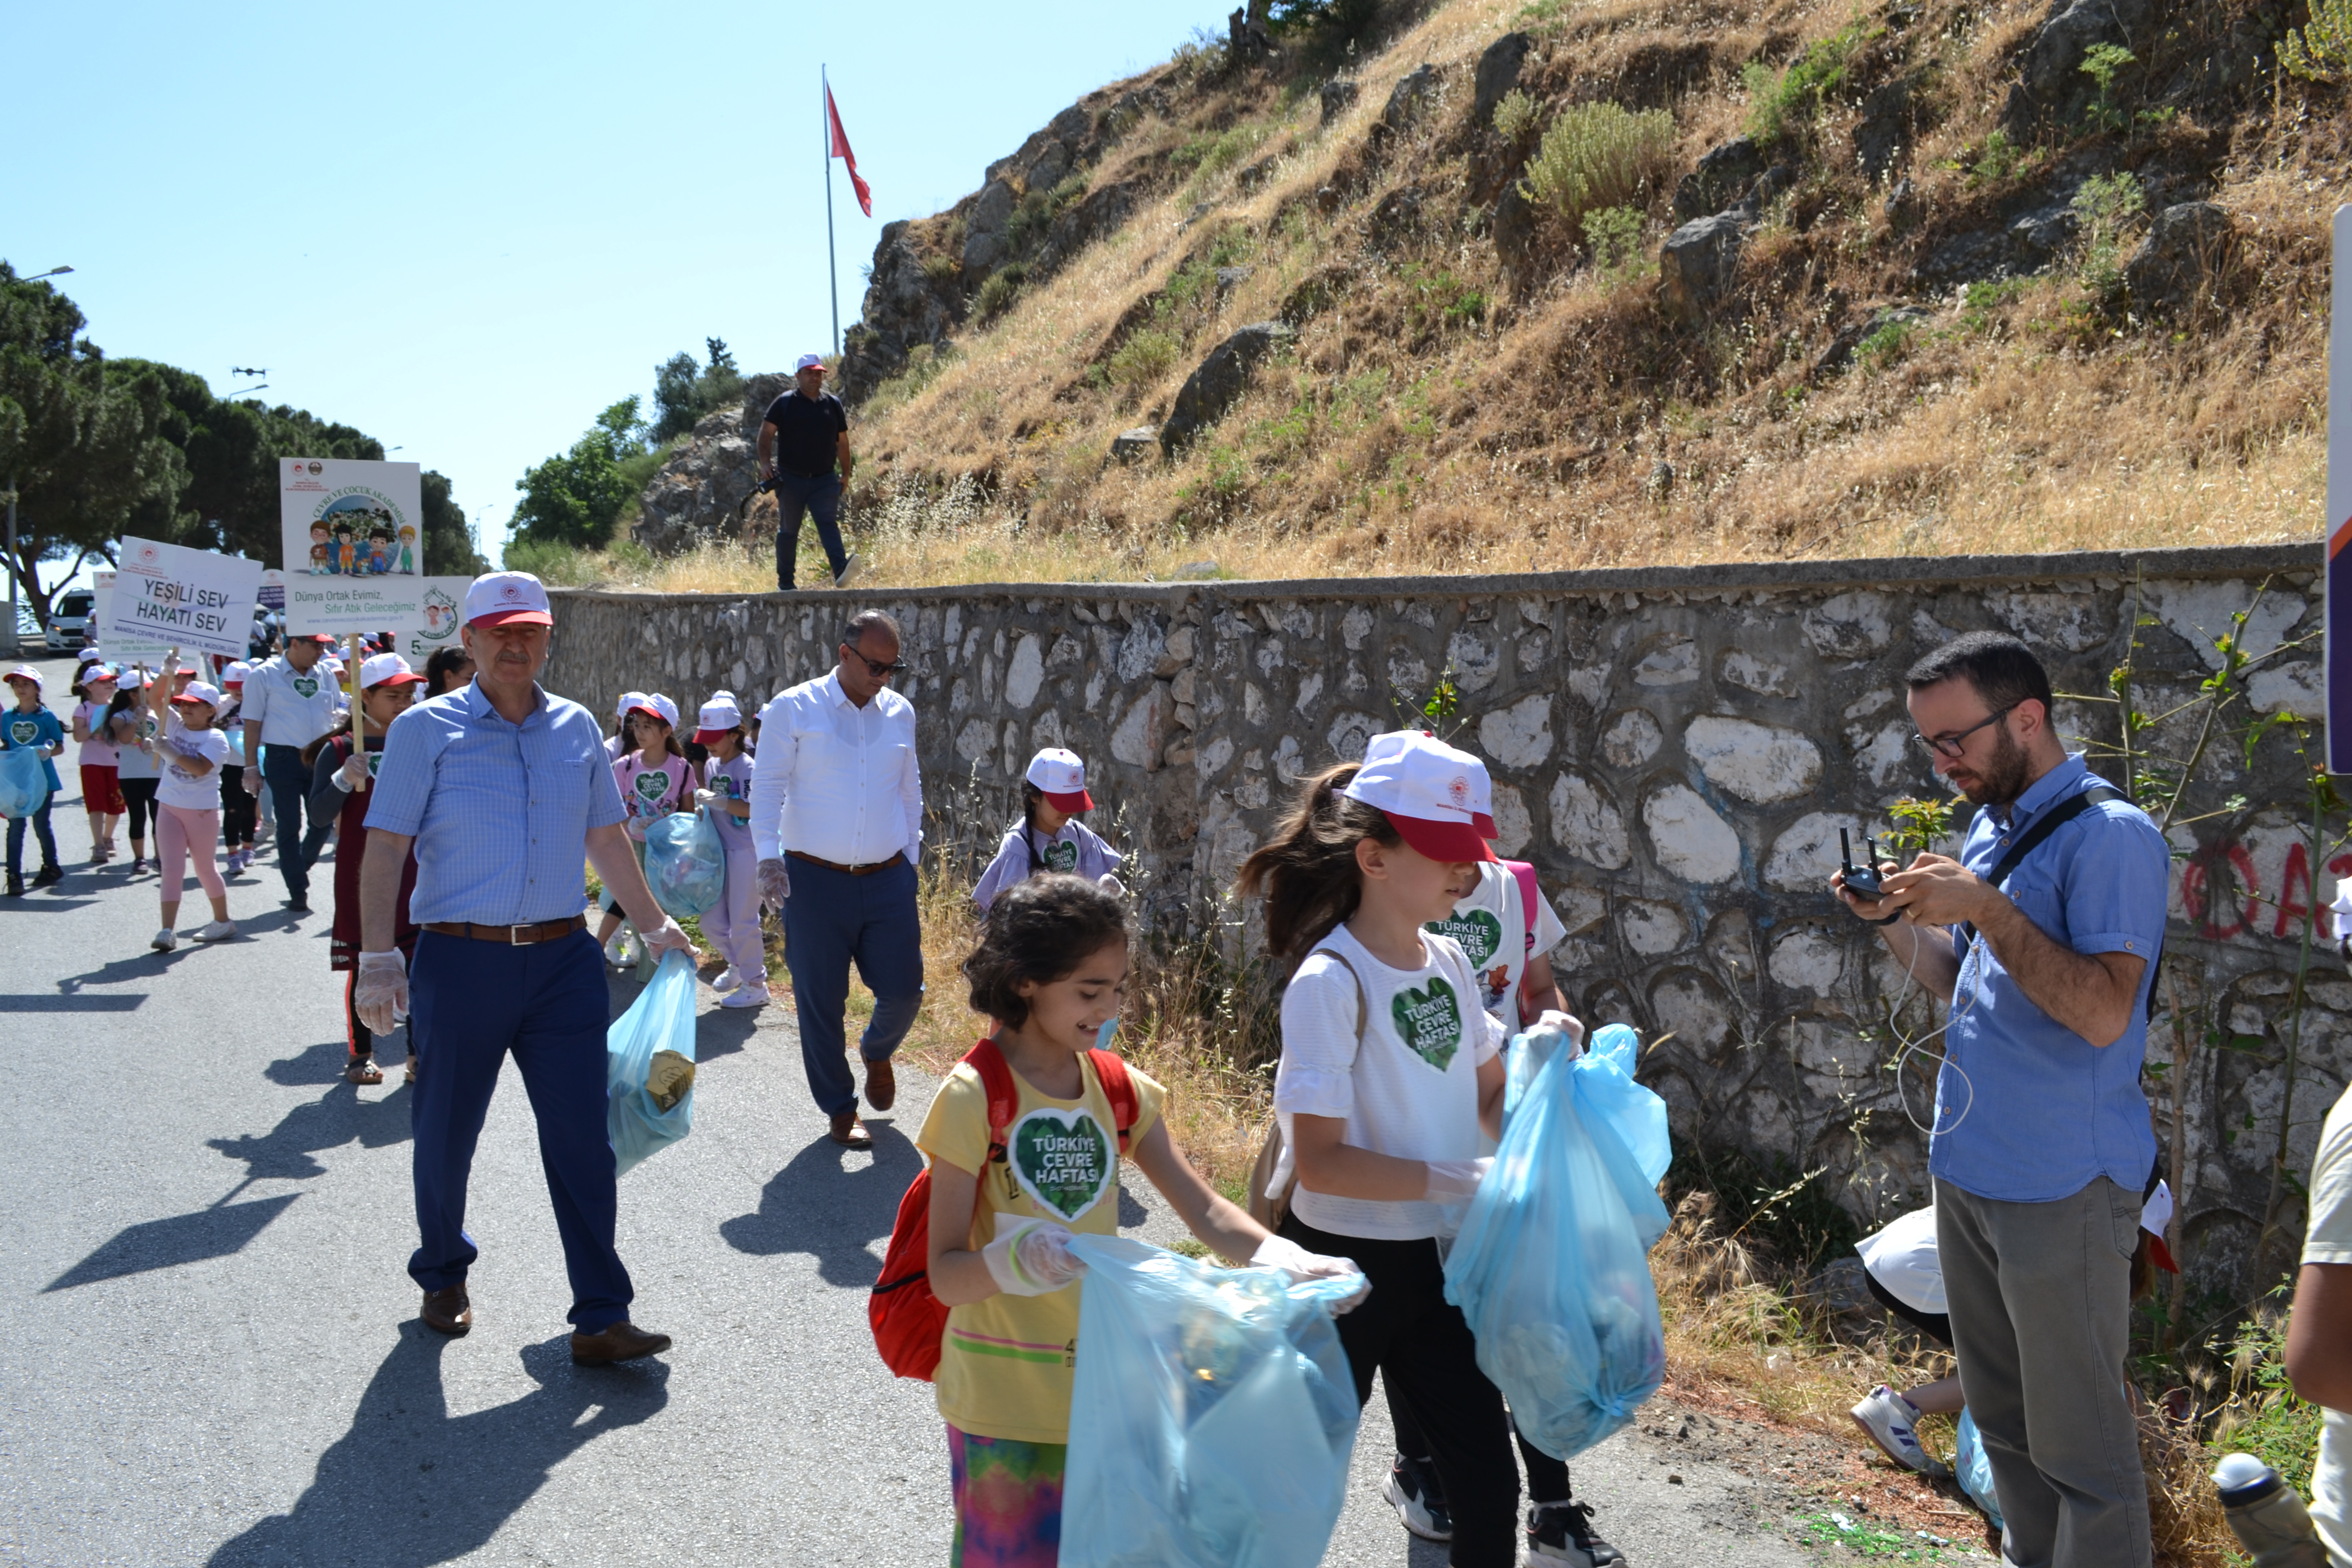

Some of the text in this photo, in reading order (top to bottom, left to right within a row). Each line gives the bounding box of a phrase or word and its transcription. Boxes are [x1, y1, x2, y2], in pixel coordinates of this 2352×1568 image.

[313, 486, 406, 524] ÇEVRE VE ÇOCUK AKADEMİSİ
[145, 579, 229, 609] YEŞİLİ SEV
[295, 589, 383, 603] Dünya Ortak Evimiz,
[325, 601, 416, 614] Sıfır Atık Geleceğimiz
[137, 601, 227, 632] HAYATI SEV
[114, 625, 136, 634] MANİSA
[137, 630, 156, 639] ÇEVRE
[166, 634, 197, 646] ŞEHİRCİLİK
[204, 642, 240, 654] MÜDÜRLÜĞÜ
[1436, 920, 1489, 936] TÜRKİYE
[1404, 994, 1452, 1022] TÜRKİYE
[1414, 1021, 1460, 1050] HAFTASI
[1416, 1009, 1453, 1036] ÇEVRE
[1032, 1134, 1096, 1152] TÜRKİYE
[1042, 1153, 1094, 1170] ÇEVRE
[1035, 1168, 1099, 1184] HAFTASI
